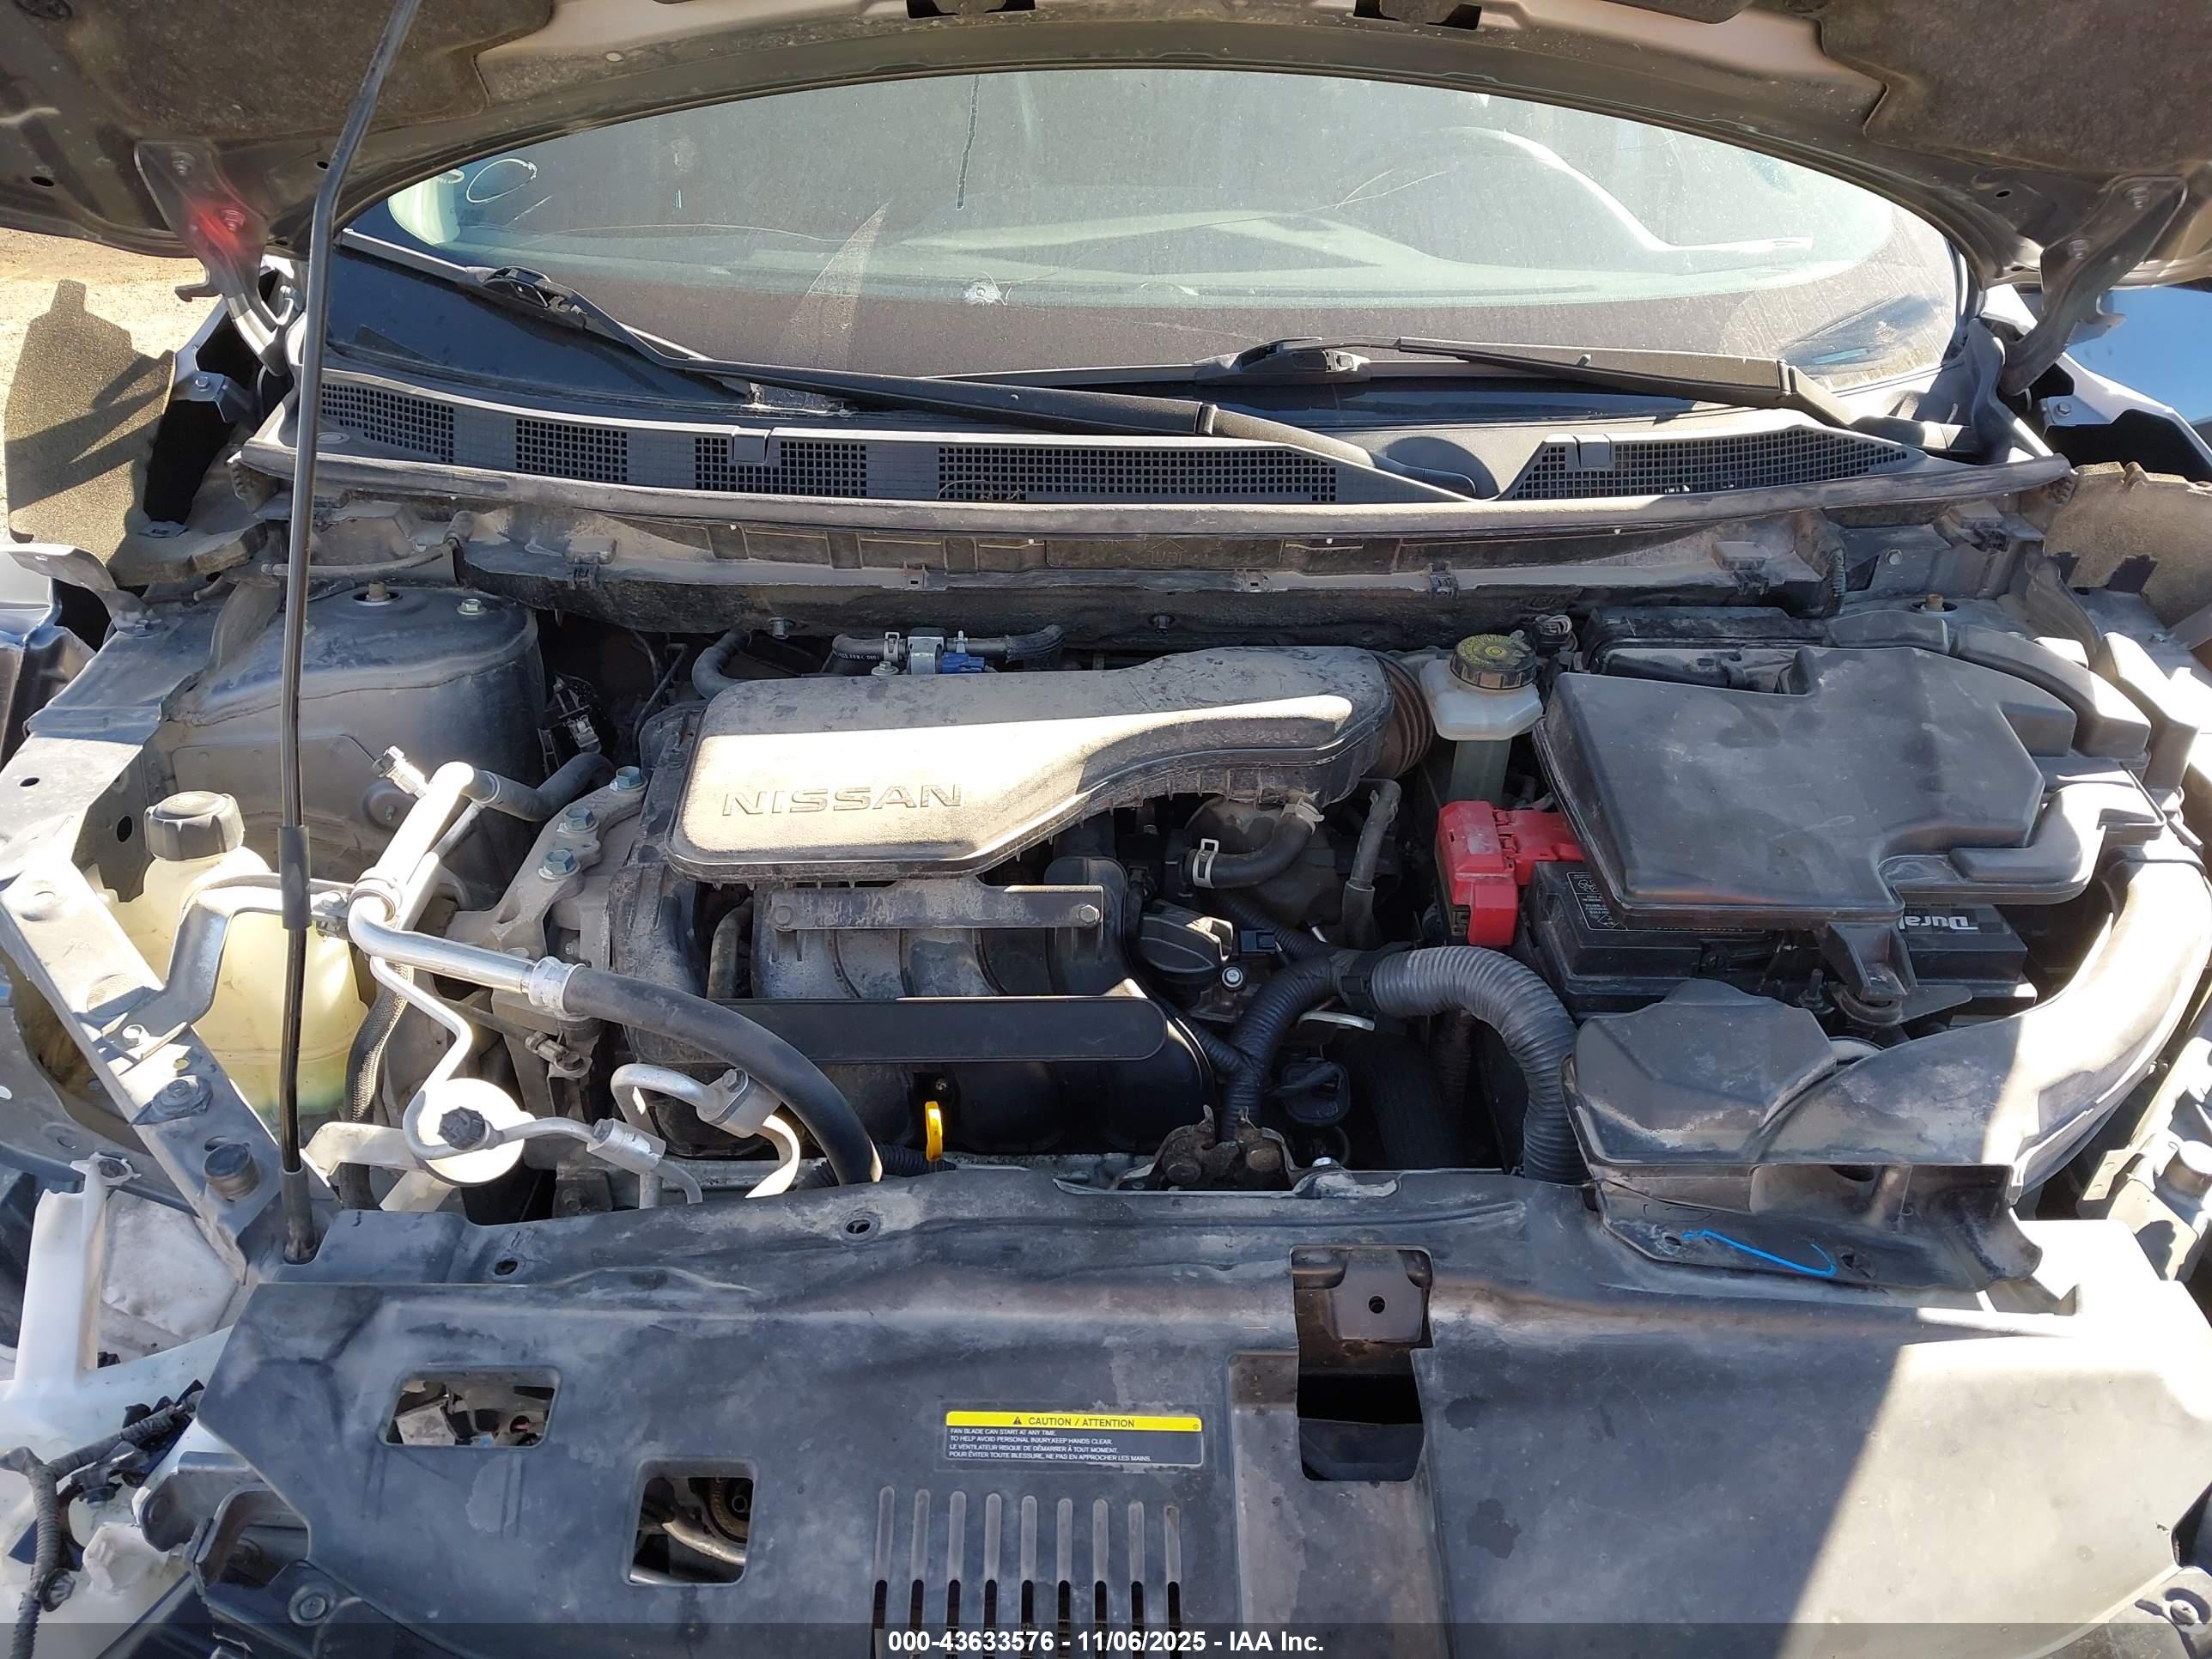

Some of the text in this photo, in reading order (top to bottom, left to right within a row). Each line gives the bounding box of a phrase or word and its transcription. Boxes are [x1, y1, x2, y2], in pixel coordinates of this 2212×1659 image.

[721, 783, 962, 817] NISSAN
[1029, 1417, 1134, 1428] CAUTION / ATTENTION
